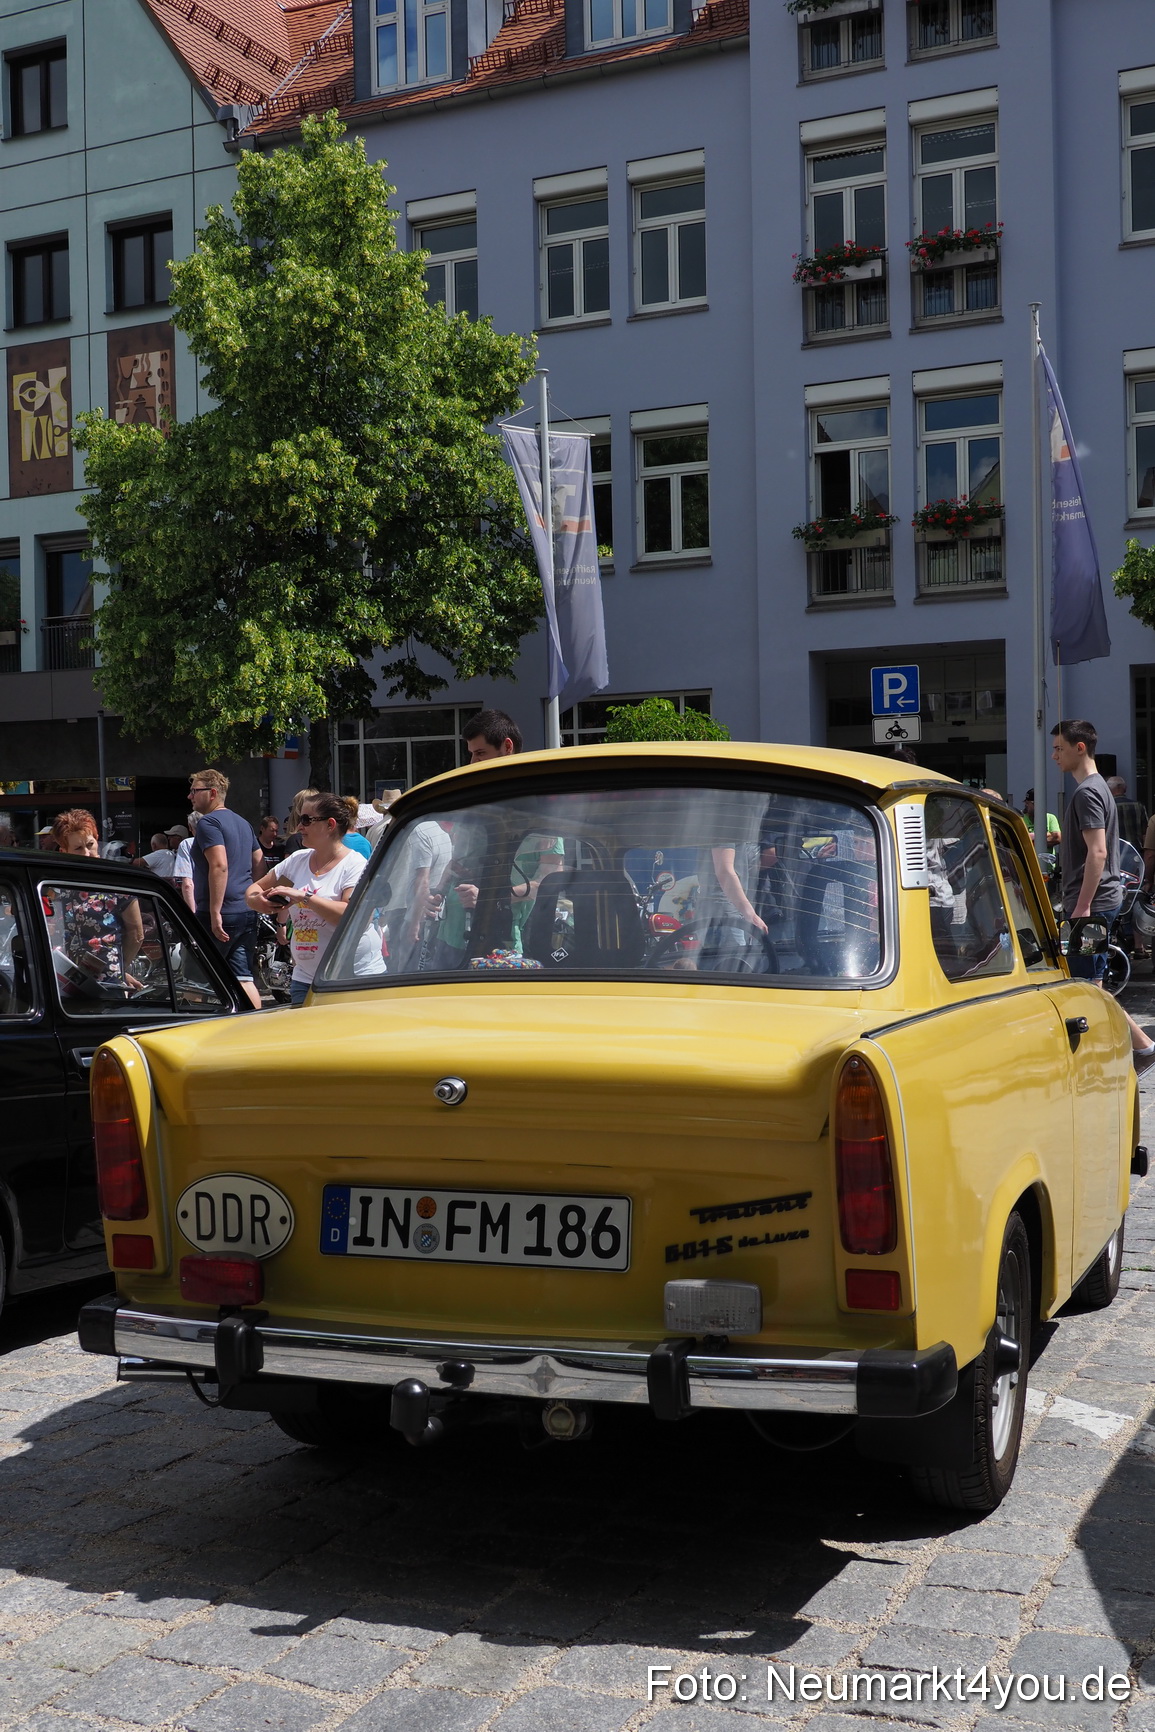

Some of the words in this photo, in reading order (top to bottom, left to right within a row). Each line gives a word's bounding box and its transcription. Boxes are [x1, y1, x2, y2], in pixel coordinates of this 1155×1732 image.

[883, 672, 908, 709] P
[195, 1191, 271, 1246] DDR
[689, 1191, 813, 1225] Trabant
[330, 1227, 340, 1242] D
[352, 1196, 412, 1249] IN
[523, 1203, 621, 1259] 186
